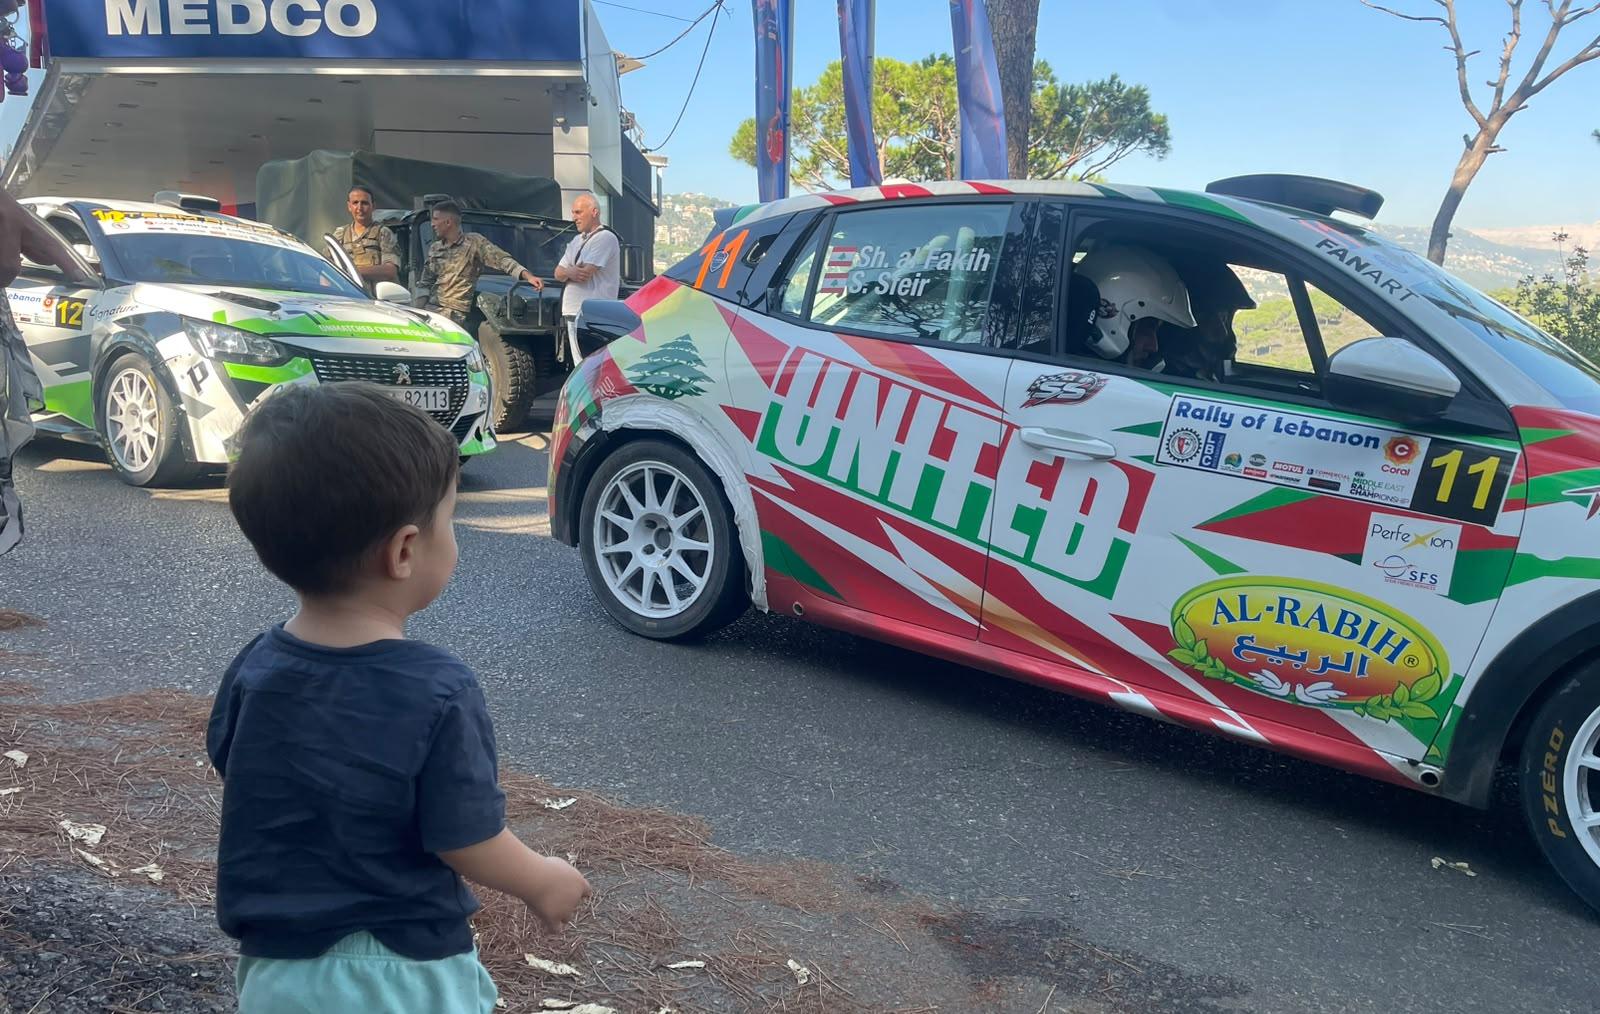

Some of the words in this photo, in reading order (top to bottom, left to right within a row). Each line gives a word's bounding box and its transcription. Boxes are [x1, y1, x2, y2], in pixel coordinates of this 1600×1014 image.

[105, 0, 378, 37] MEDCO
[693, 228, 750, 289] 11
[858, 245, 889, 269] Sh.
[924, 247, 991, 272] Fakih
[1315, 238, 1420, 302] FANART
[8, 292, 41, 303] ebanon
[849, 270, 868, 294] S.
[874, 271, 931, 297] Sfeir
[57, 300, 84, 326] 12
[404, 390, 448, 408] 82113
[1175, 401, 1235, 429] Rally
[1241, 413, 1267, 431] of
[1273, 416, 1380, 450] Lebanon
[773, 350, 1133, 584] UNITED
[1275, 462, 1303, 473] MOTUL
[1381, 464, 1410, 476] Coral
[1431, 449, 1500, 510] 11
[1409, 570, 1439, 585] SFS
[1232, 634, 1373, 678] الربيع
[1541, 727, 1566, 816] ZERO
